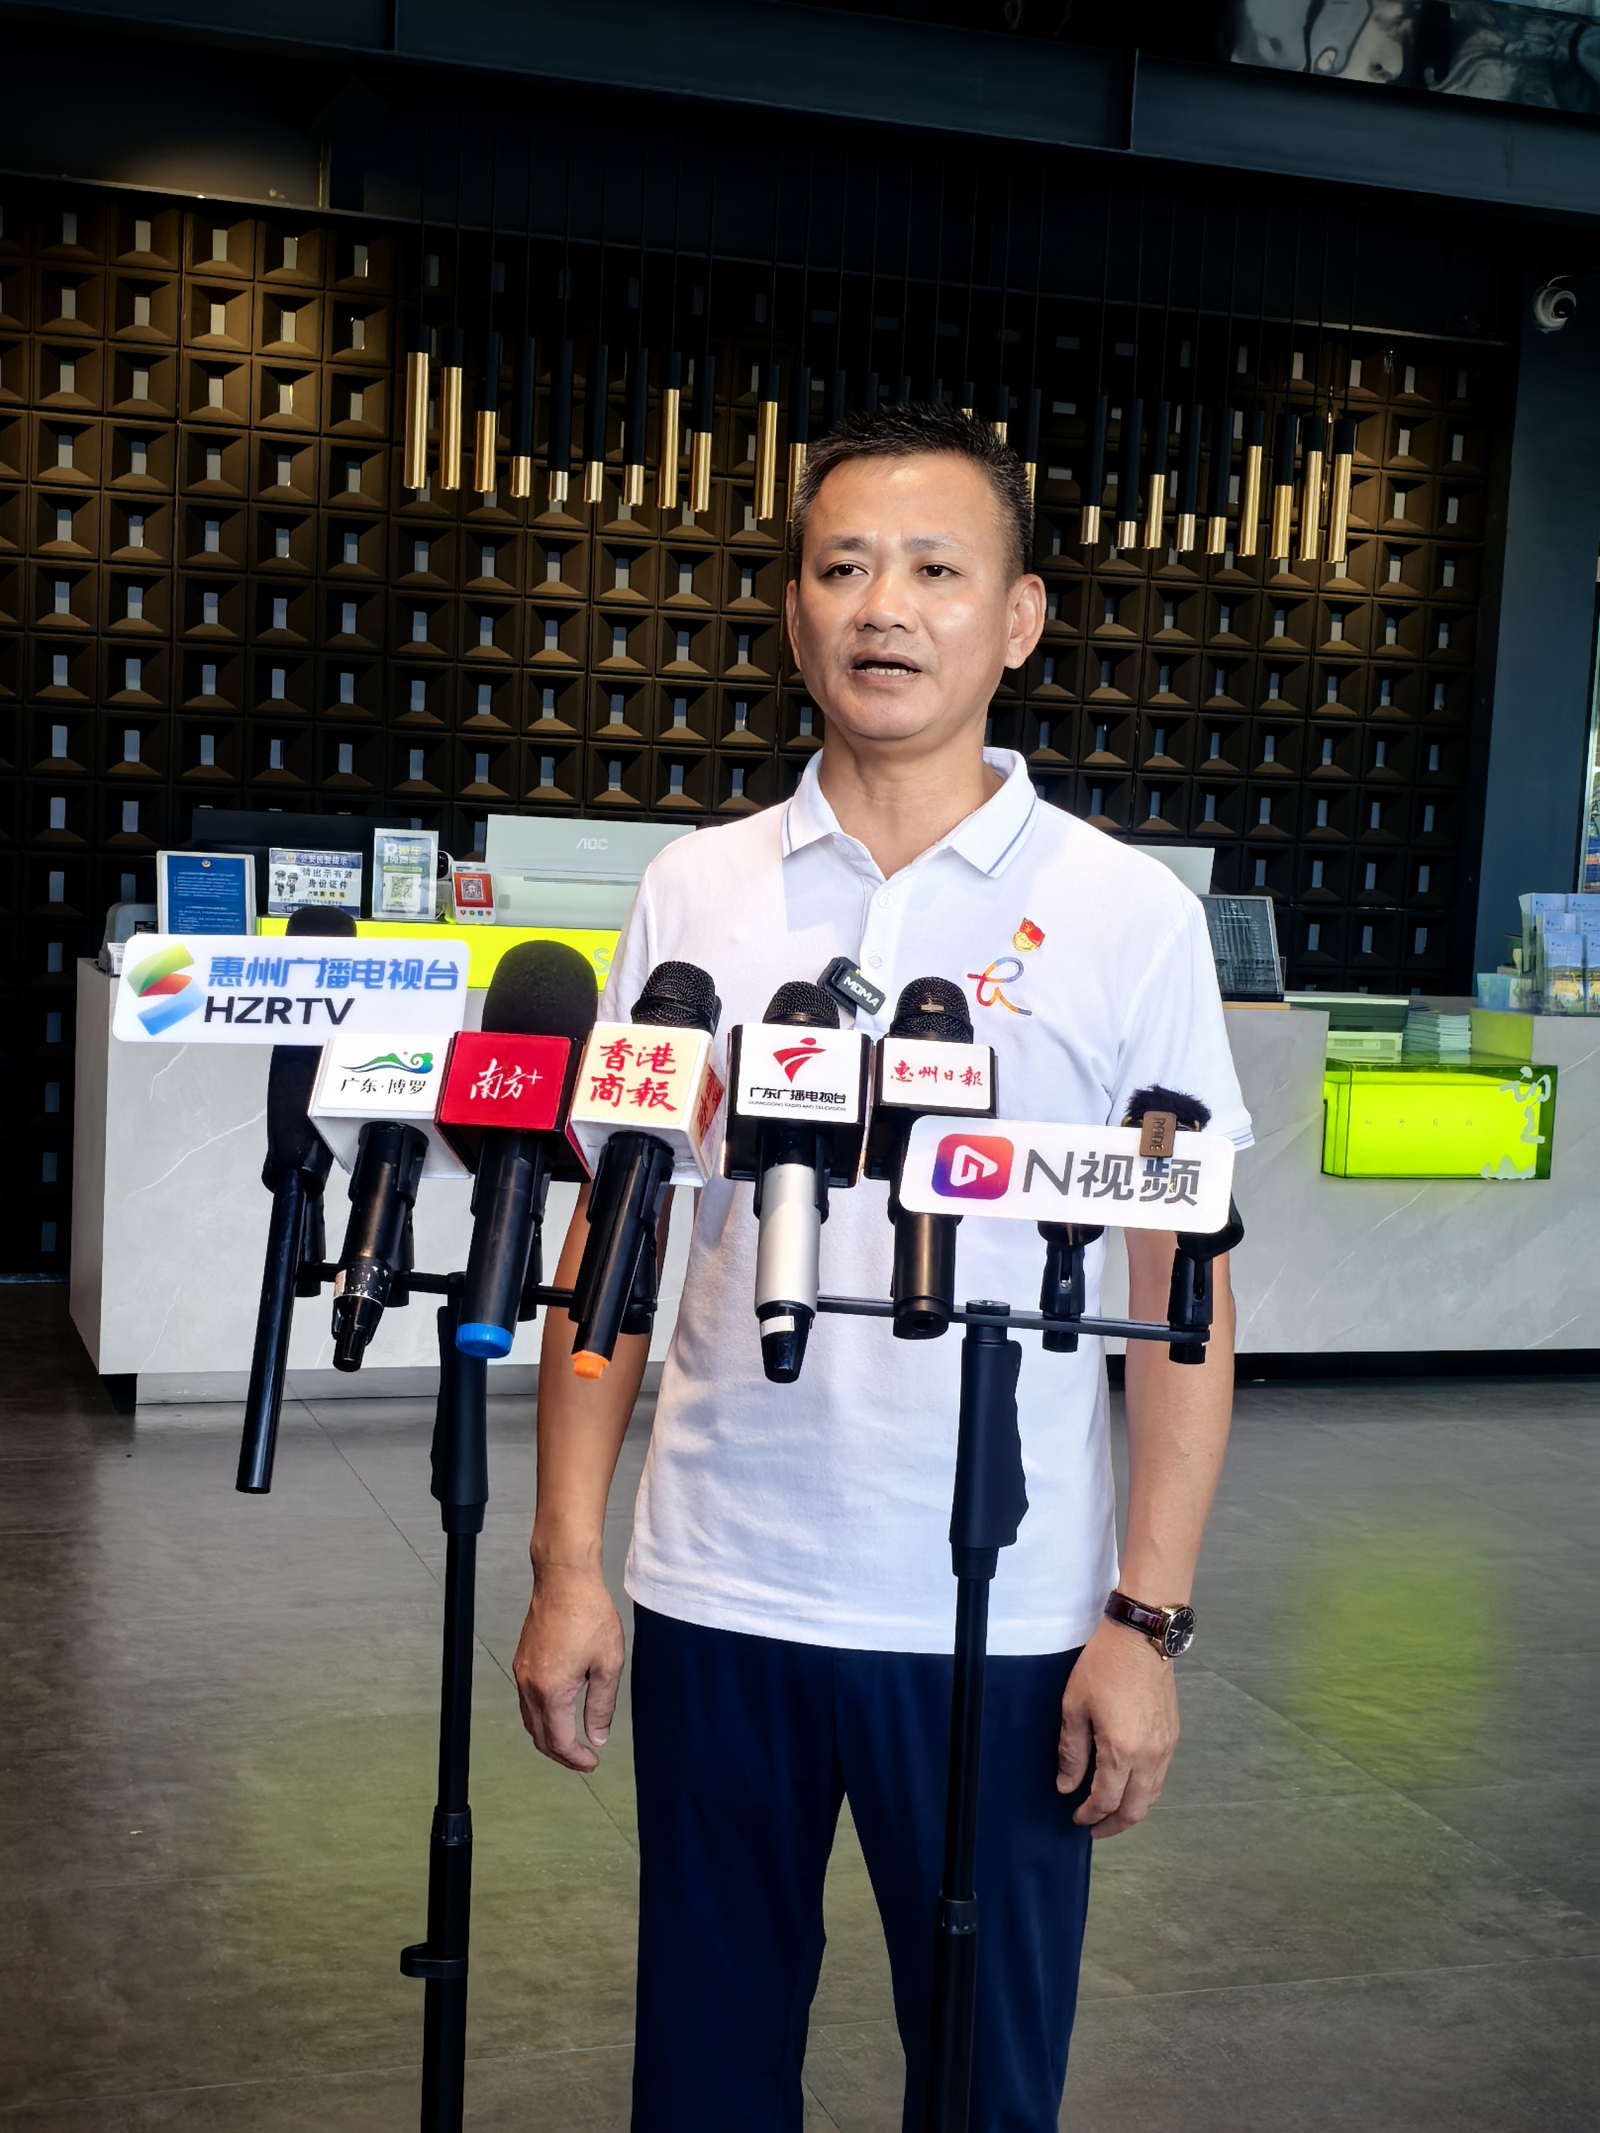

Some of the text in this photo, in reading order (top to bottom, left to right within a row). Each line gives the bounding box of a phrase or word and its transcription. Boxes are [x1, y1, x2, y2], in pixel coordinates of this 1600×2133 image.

[576, 837, 608, 850] AOC
[208, 956, 460, 991] 惠州广播电视台
[204, 996, 355, 1025] HZRTV
[600, 1037, 677, 1075] 香港
[750, 1087, 846, 1104] 广东广播电视台
[1022, 1149, 1201, 1206] N视频
